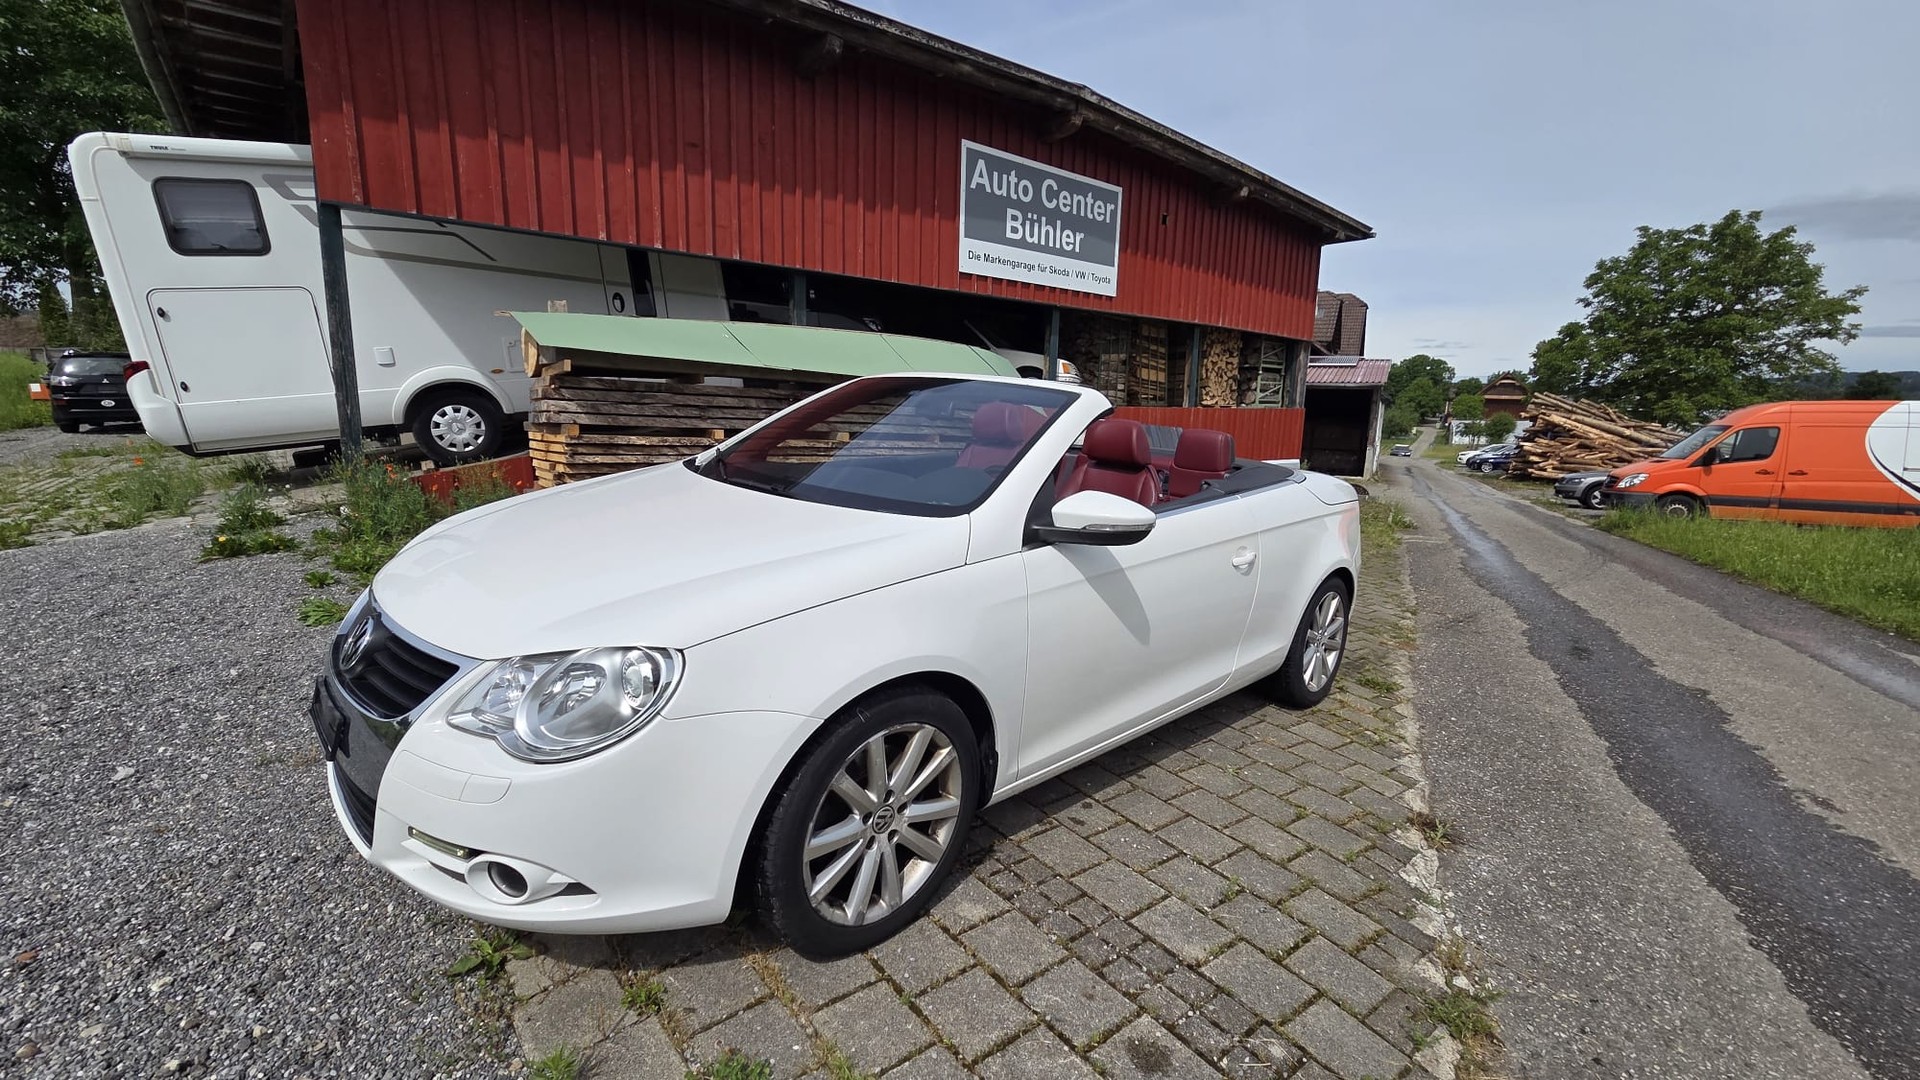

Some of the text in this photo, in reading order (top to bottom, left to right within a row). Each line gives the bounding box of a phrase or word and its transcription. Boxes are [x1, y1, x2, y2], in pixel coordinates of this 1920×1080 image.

[970, 158, 1115, 223] Auto Center
[1005, 207, 1084, 253] Bühler
[968, 250, 981, 261] Die
[983, 253, 1036, 273] Markengarage
[1037, 263, 1048, 273] für
[1048, 265, 1070, 277] Skoda
[1074, 271, 1086, 280] VW
[1091, 273, 1111, 284] Toyota
